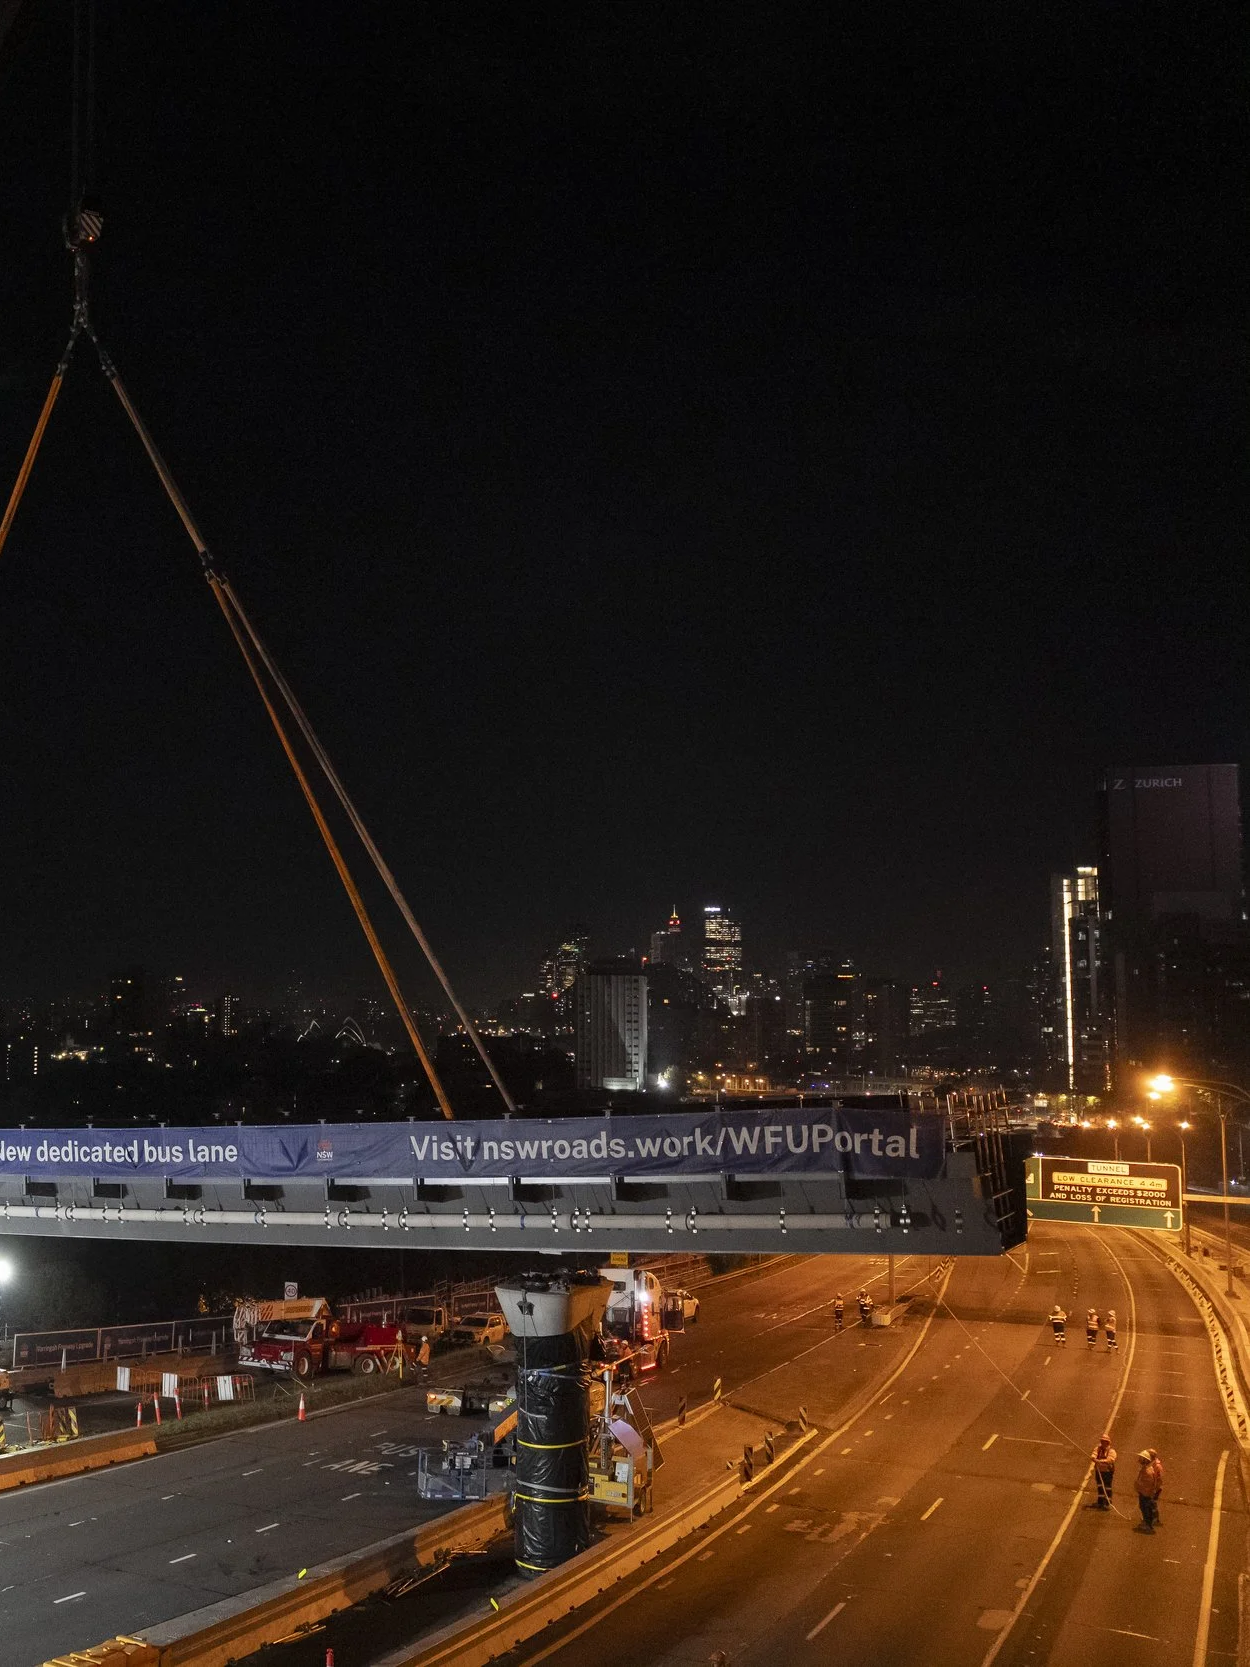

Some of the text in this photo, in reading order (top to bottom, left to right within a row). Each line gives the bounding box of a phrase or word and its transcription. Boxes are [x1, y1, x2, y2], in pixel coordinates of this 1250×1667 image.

[1135, 778, 1183, 788] ZURICH
[410, 1123, 920, 1161] Visit nswroads.work/WFUPortal
[36, 1140, 139, 1164] dedicated
[144, 1140, 184, 1164] bus
[189, 1139, 238, 1164] lane
[316, 1150, 333, 1159] NSW
[1091, 1164, 1127, 1174] TUNNEL
[1057, 1175, 1076, 1183] LOW
[1080, 1177, 1135, 1187] CLEARANCE
[1054, 1185, 1166, 1199] PENALTY EXCEEDS $2000
[1050, 1192, 1067, 1200] AND
[1070, 1193, 1092, 1202] LOSS
[1110, 1197, 1172, 1207] REGISTRATION
